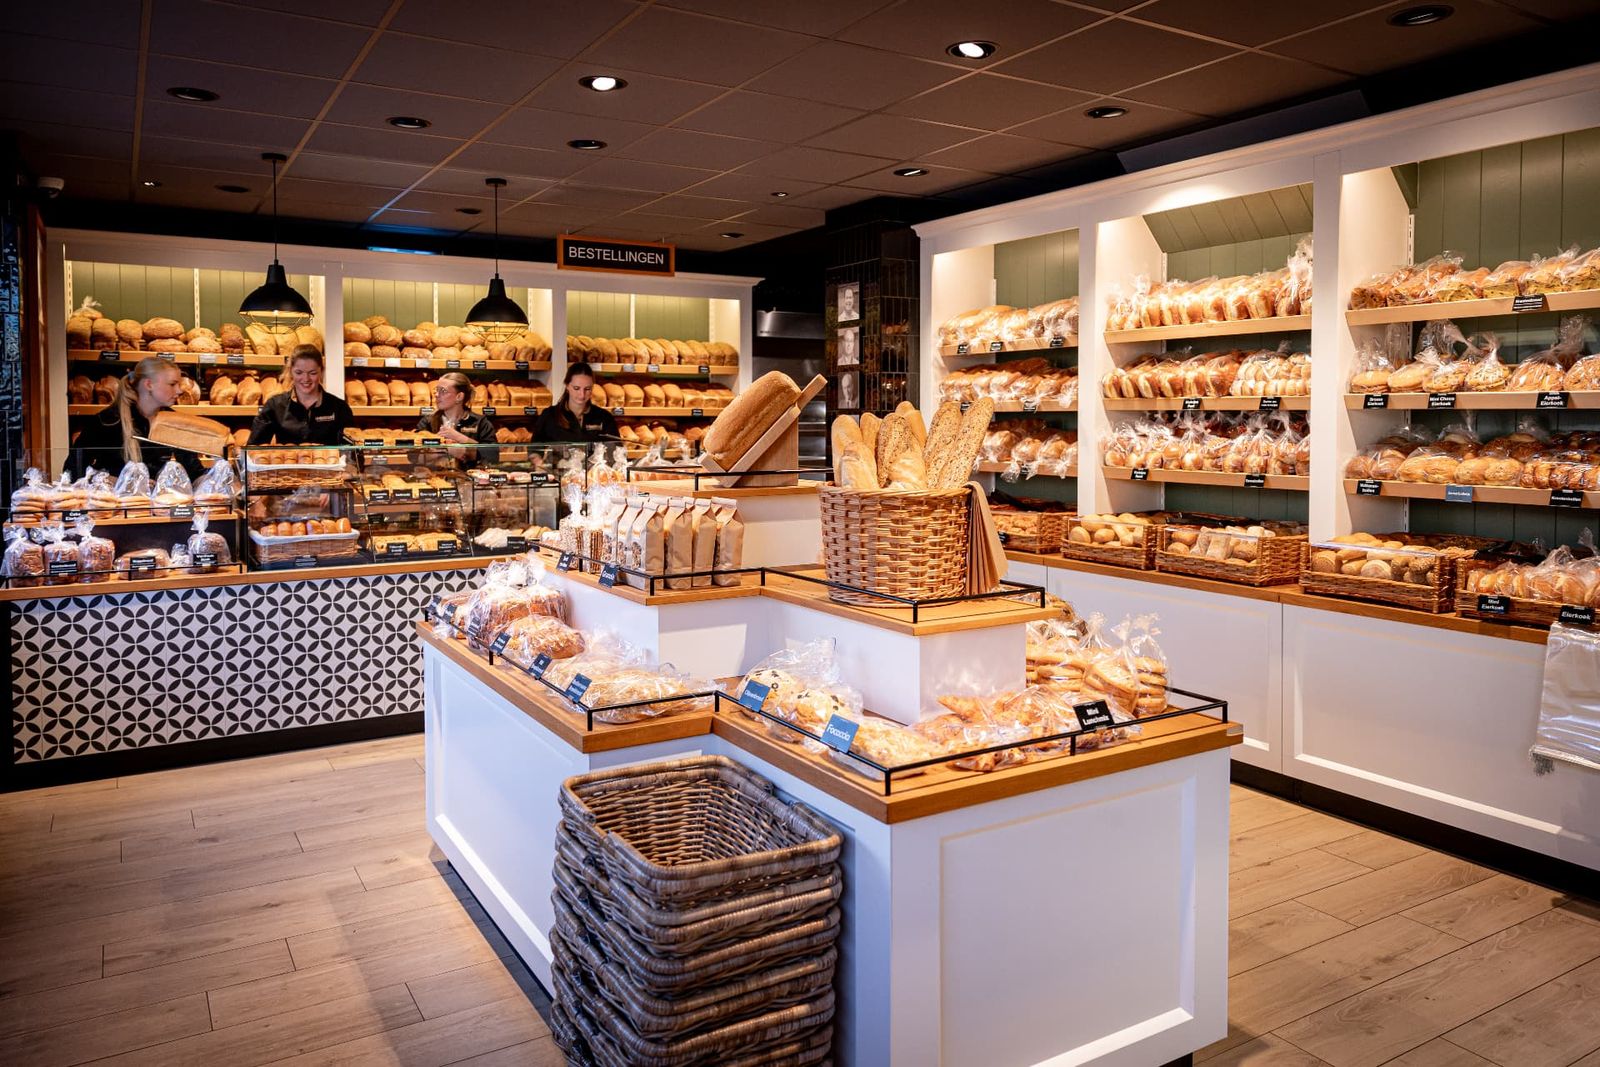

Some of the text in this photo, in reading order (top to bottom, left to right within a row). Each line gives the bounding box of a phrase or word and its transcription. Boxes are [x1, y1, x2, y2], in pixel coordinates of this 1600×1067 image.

[569, 246, 664, 264] BESTELLINGEN
[1561, 610, 1591, 620] Eierkoek
[827, 723, 851, 741] Focaccia
